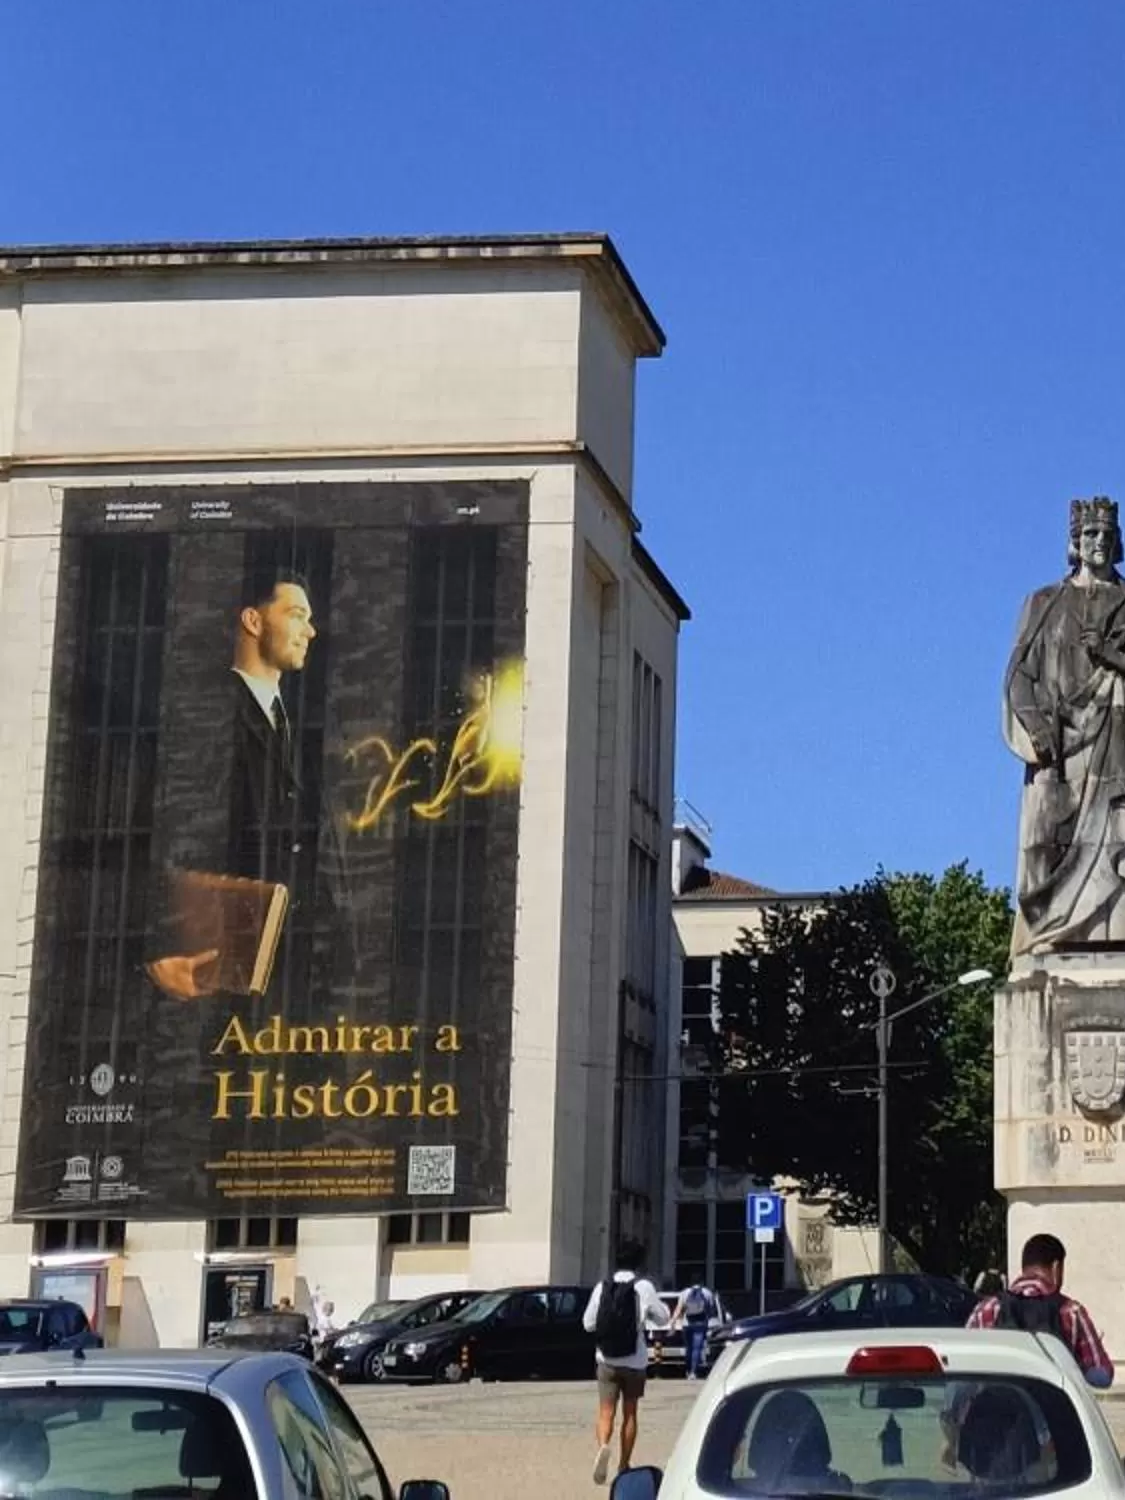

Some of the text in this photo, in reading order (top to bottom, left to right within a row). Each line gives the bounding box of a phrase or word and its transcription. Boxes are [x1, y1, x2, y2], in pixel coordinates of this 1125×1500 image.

[210, 1014, 462, 1055] Admirar a
[212, 1068, 460, 1120] História
[754, 1197, 775, 1225] P
